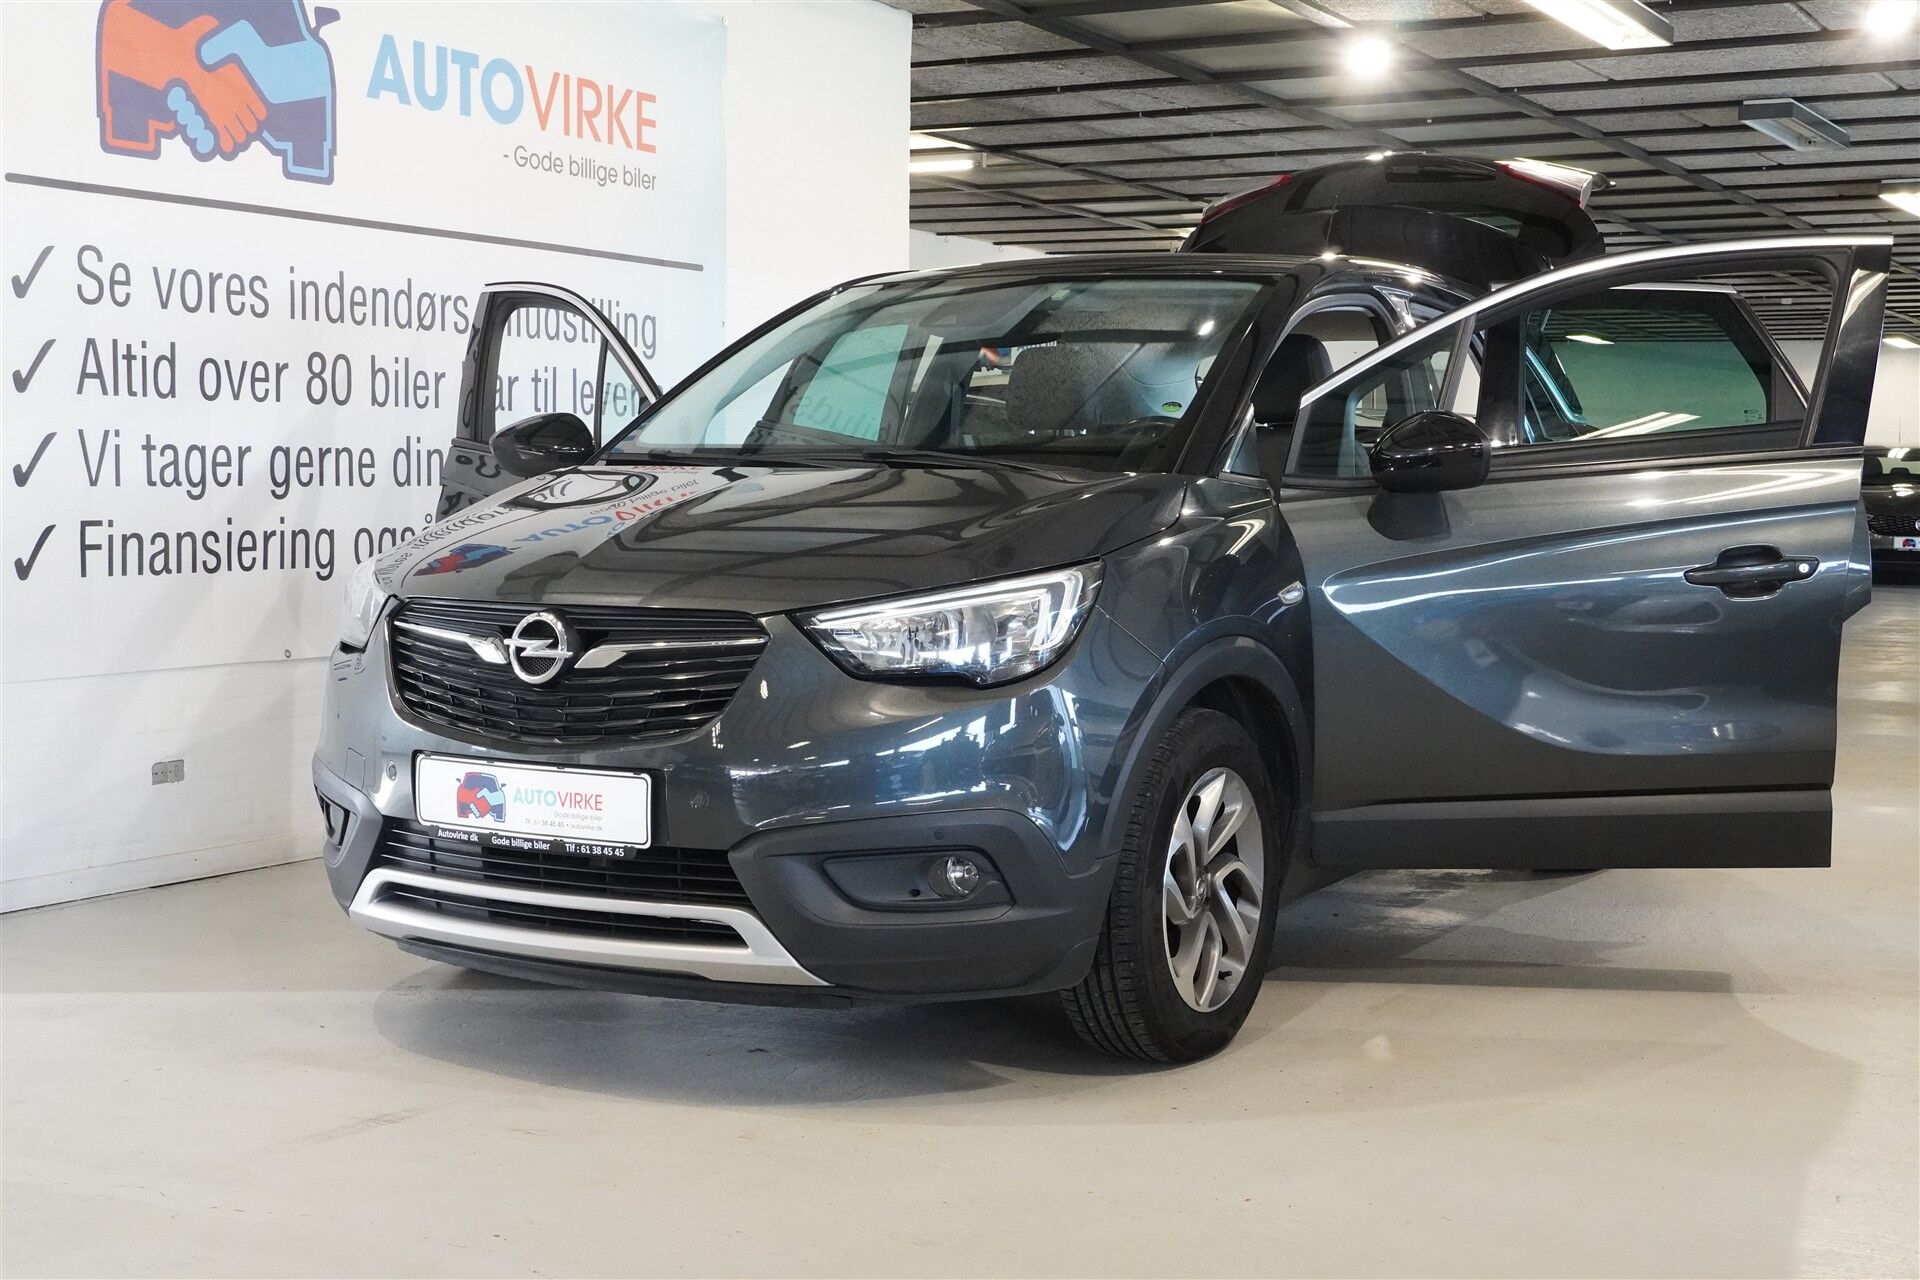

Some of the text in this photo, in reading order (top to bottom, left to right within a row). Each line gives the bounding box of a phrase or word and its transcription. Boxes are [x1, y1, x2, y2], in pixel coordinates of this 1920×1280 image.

[366, 33, 657, 154] AUTOVIRKE
[513, 145, 564, 174] Gode
[568, 152, 619, 187] billige
[622, 165, 657, 191] biler
[77, 245, 132, 310] Se
[151, 266, 270, 319] vores
[289, 266, 470, 335] indendørs
[76, 337, 177, 400] Altid
[198, 357, 290, 409] over
[305, 350, 353, 407] 80
[370, 355, 447, 410] biler
[531, 365, 557, 413] til
[77, 428, 445, 501] Vi tager gerne din
[79, 516, 336, 583] Finansiering
[513, 787, 603, 812] AUTOVIRKE
[437, 829, 469, 841] Autovirke
[491, 836, 510, 846] Gode
[511, 838, 533, 850] billige
[533, 841, 551, 850] biler
[565, 843, 576, 852] Tlf
[580, 845, 591, 854] 61
[592, 846, 602, 855] 38
[603, 847, 613, 856] 45
[614, 848, 625, 857] 45
